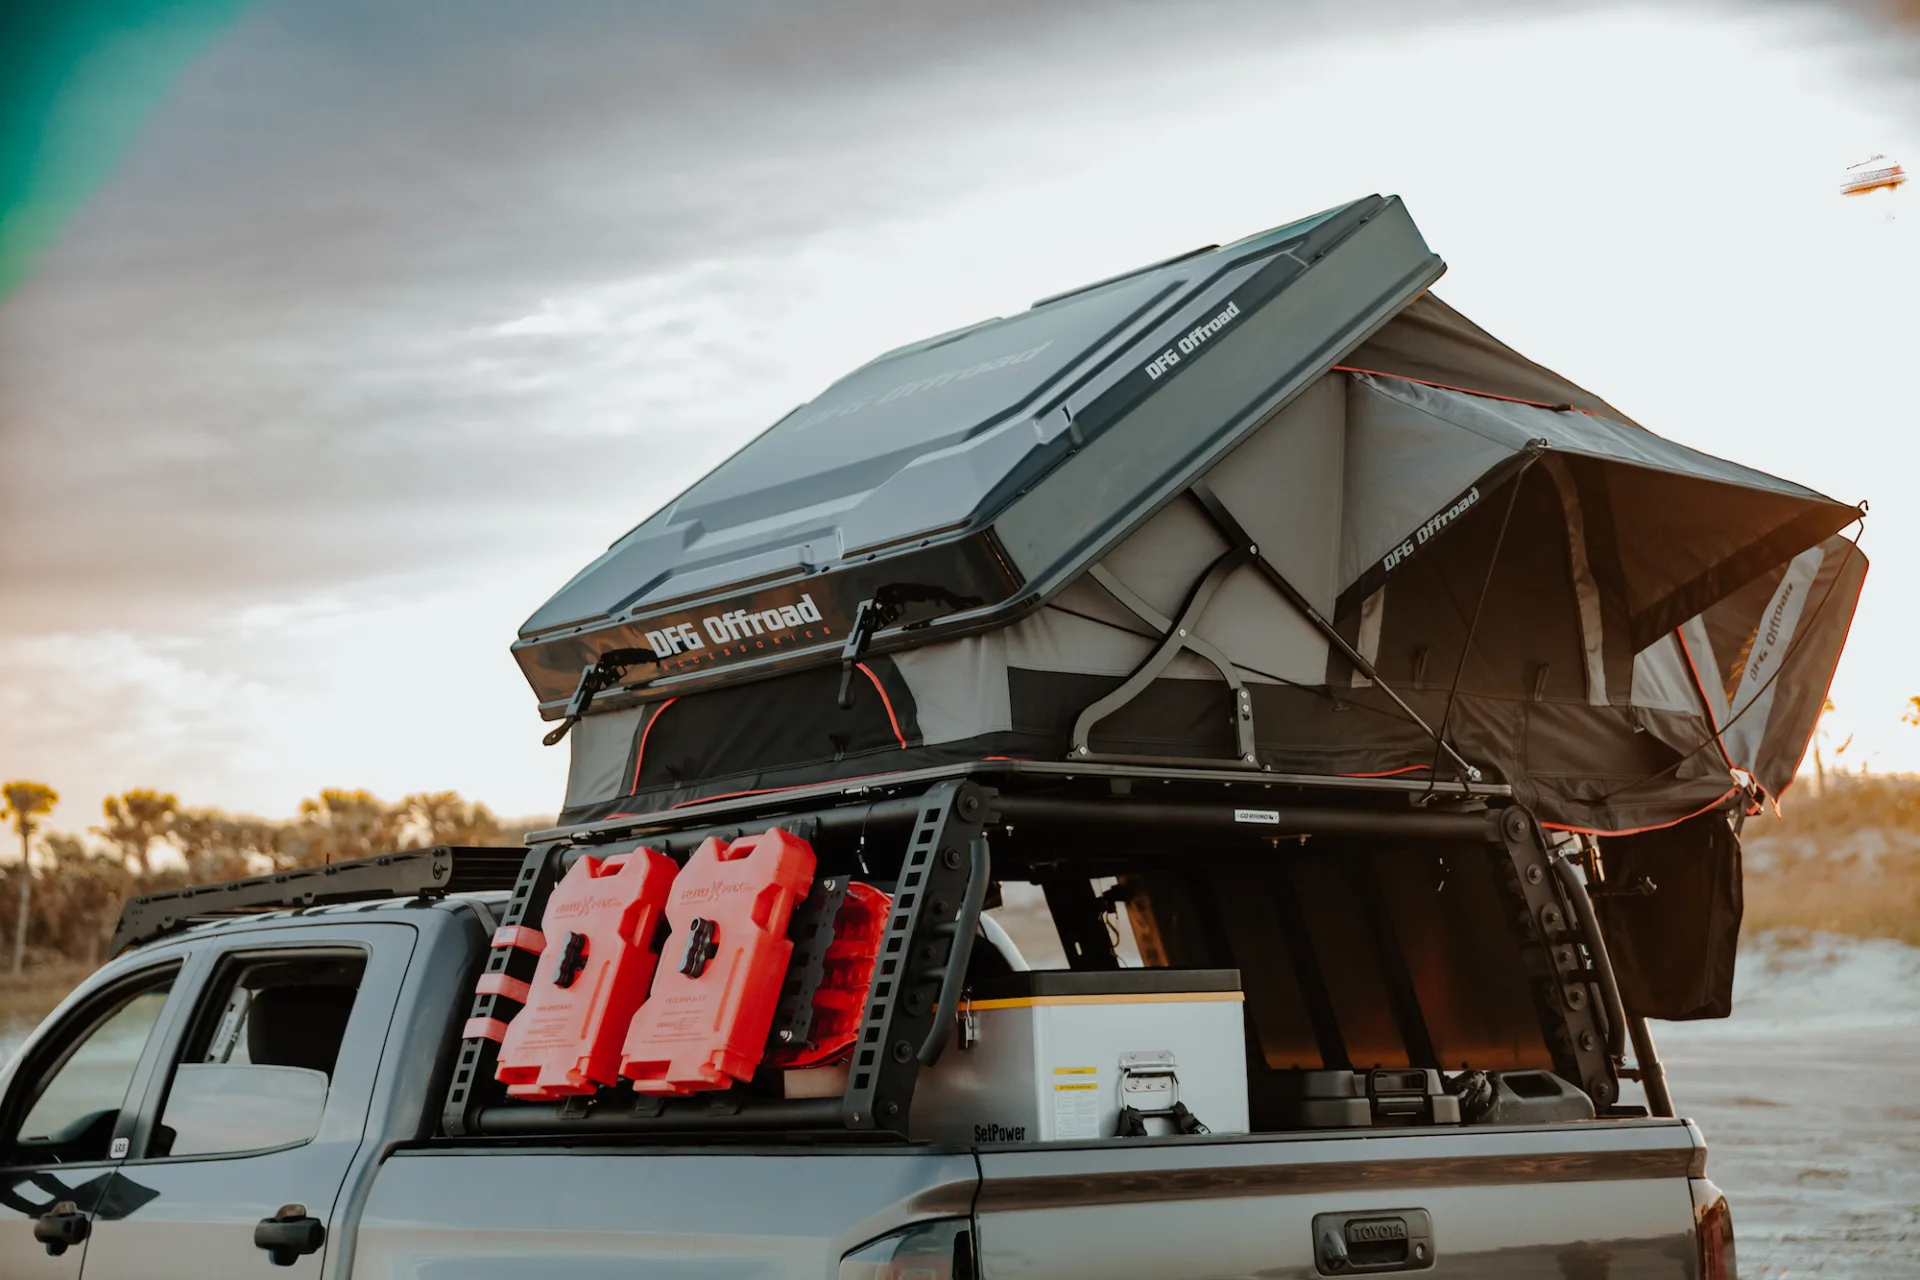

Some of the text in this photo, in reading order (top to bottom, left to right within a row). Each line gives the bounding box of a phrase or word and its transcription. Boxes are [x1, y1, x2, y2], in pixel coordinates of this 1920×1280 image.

[1144, 300, 1241, 381] DFG Offroad
[1383, 486, 1480, 572] DFG Offroad
[645, 593, 824, 658] DFG Offroad
[662, 626, 832, 672] ACCESSORIES
[1239, 812, 1249, 820] GO
[973, 1123, 1026, 1143] SetPower
[1353, 1223, 1406, 1241] TOYOTA
